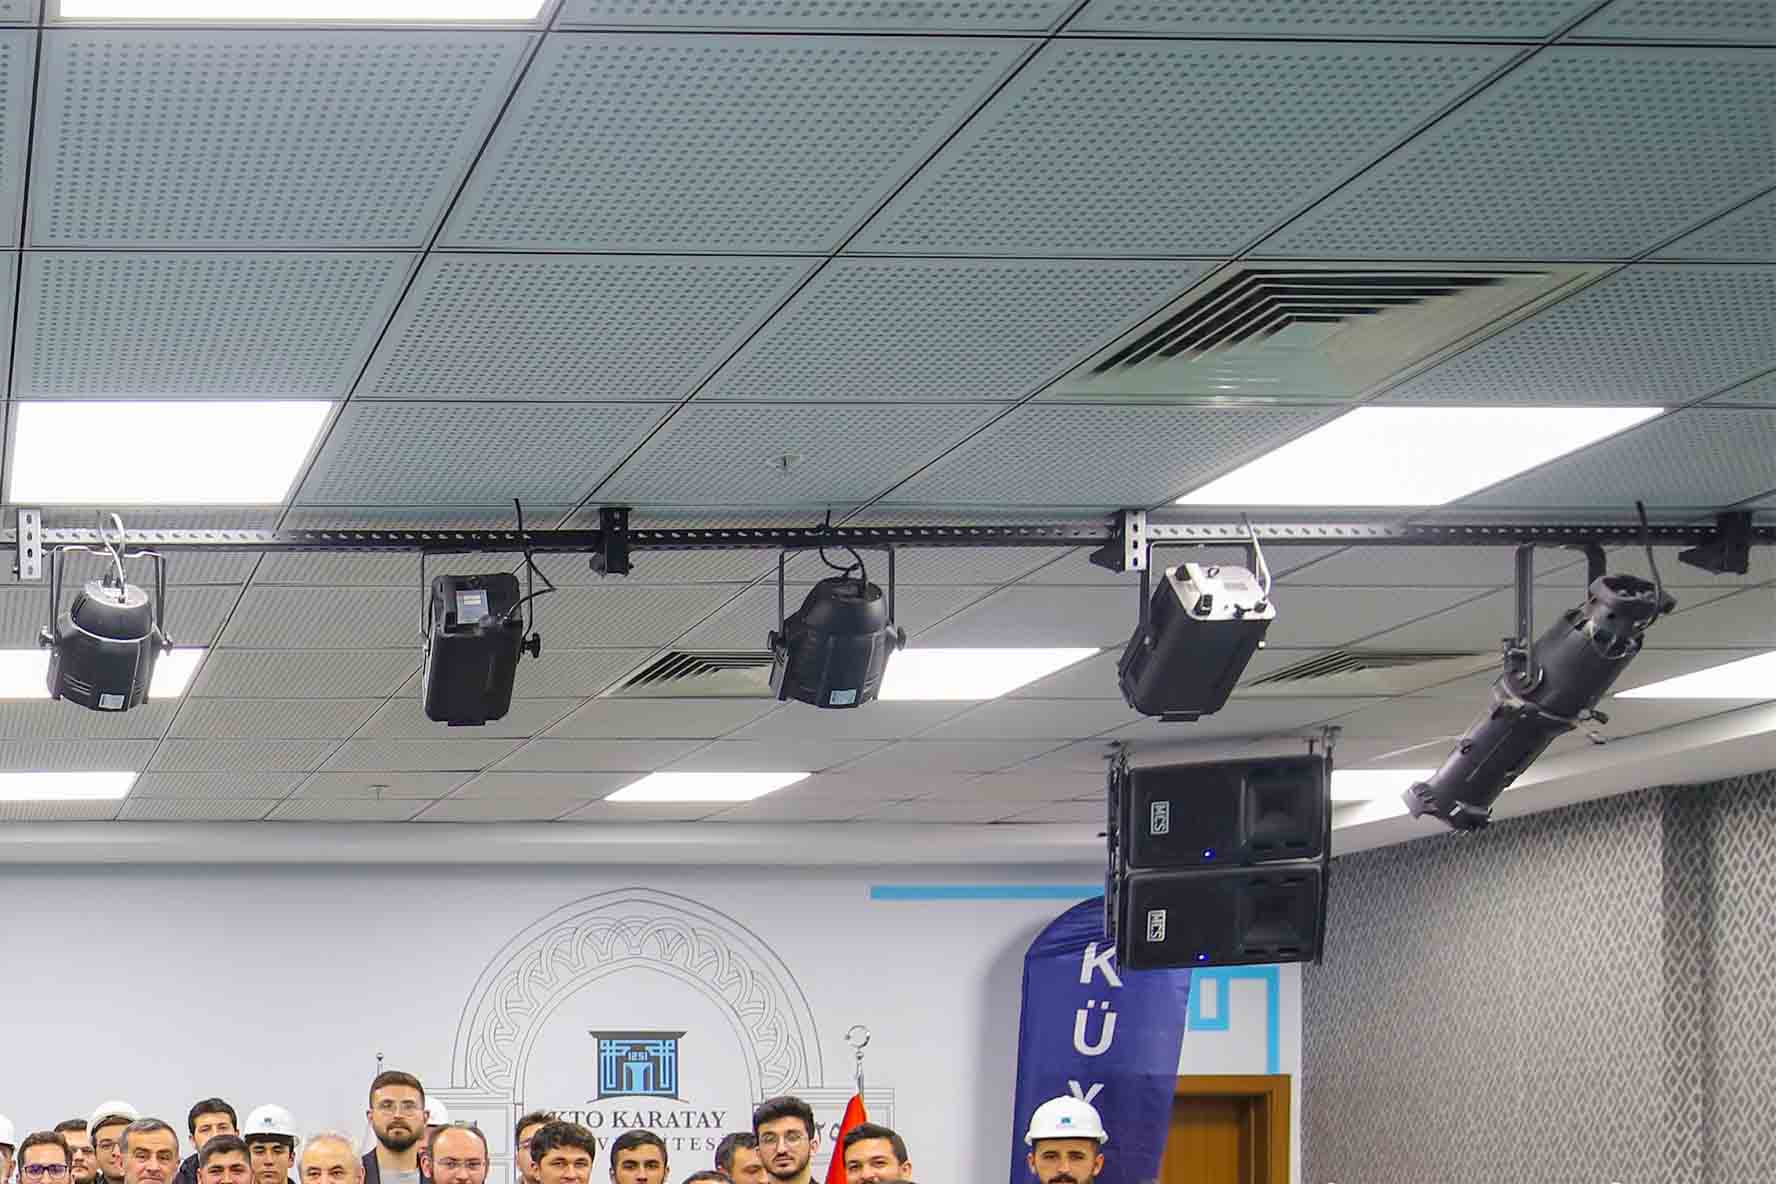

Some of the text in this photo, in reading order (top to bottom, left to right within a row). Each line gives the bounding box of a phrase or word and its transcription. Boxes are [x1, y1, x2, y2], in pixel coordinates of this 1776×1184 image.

[1153, 802, 1167, 833] MCS
[1150, 911, 1164, 940] MCS
[1067, 941, 1123, 1104] KÜY
[612, 1111, 726, 1129] KARATAY
